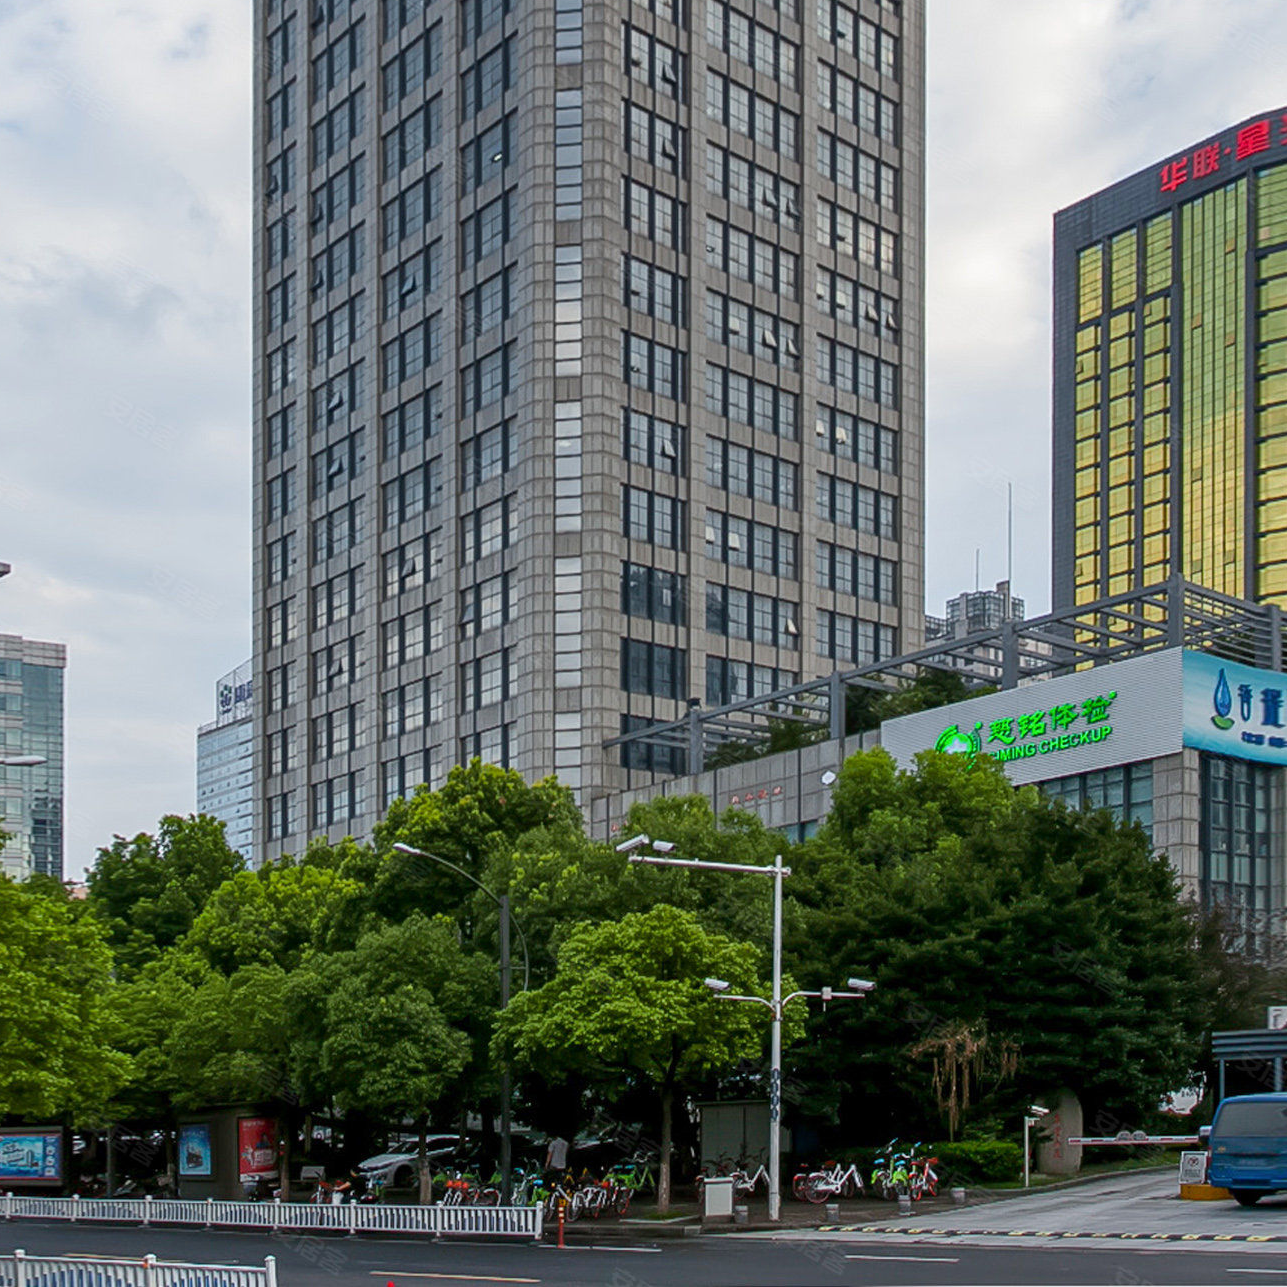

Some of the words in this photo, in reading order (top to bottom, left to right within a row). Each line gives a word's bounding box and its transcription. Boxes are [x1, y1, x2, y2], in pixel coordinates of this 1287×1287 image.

[986, 695, 1112, 744] 慈铭体检
[987, 742, 1037, 763] IMING
